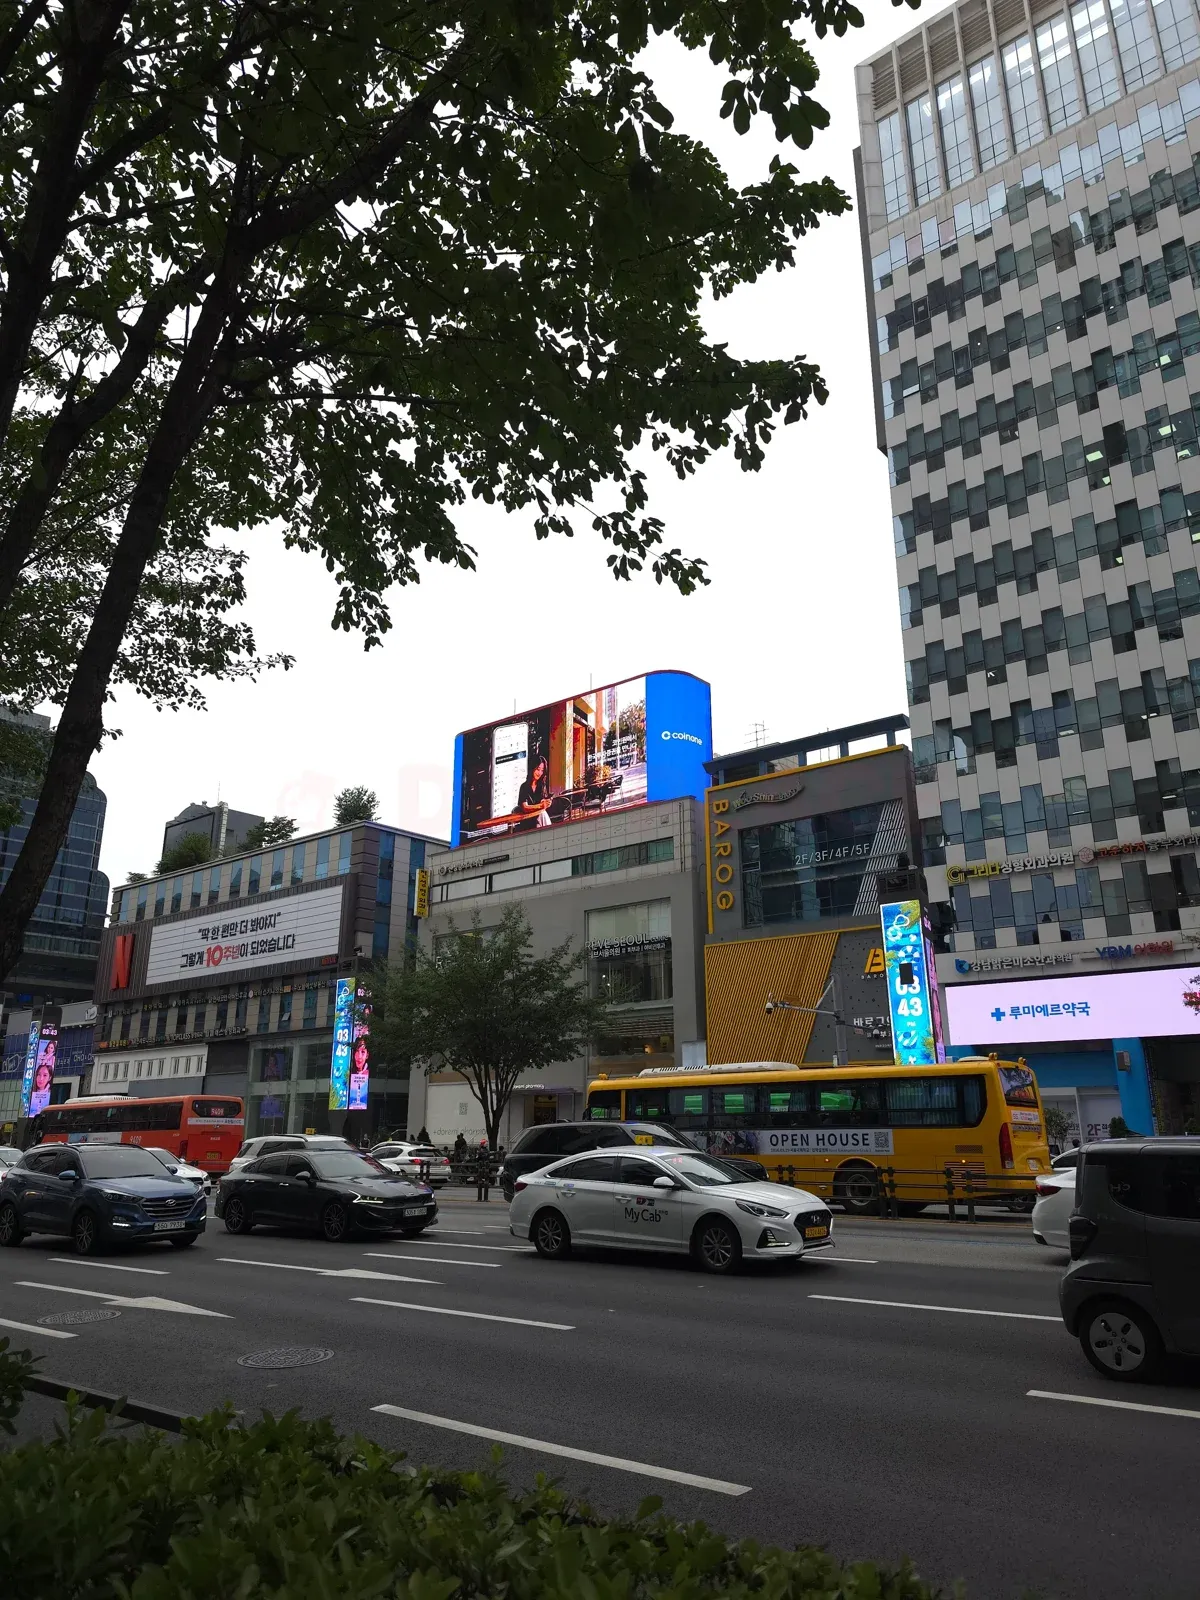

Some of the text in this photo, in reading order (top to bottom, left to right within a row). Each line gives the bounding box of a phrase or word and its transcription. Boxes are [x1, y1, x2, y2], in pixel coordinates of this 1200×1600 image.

[672, 732, 703, 746] coinone
[711, 798, 735, 911] BAROG
[795, 843, 872, 866] 2F/3F/4F/5F
[965, 851, 1074, 878] 그리다성형외과의원
[211, 925, 220, 940] 한
[221, 922, 238, 938] 편만
[239, 920, 248, 936] 더
[613, 933, 649, 948] SEOUL
[180, 934, 295, 968] 그렇게 10주년이 되었습니다
[1095, 944, 1132, 961] YBM
[971, 953, 1073, 972] 강남밝은미소안과의원
[861, 972, 888, 980] BARO
[897, 997, 923, 1018] 43
[1009, 1002, 1090, 1019] 루미에르약국
[337, 1028, 349, 1042] 03
[336, 1045, 348, 1057] 43
[1087, 1124, 1101, 1136] 2F
[770, 1133, 870, 1147] OPEN HOUSE
